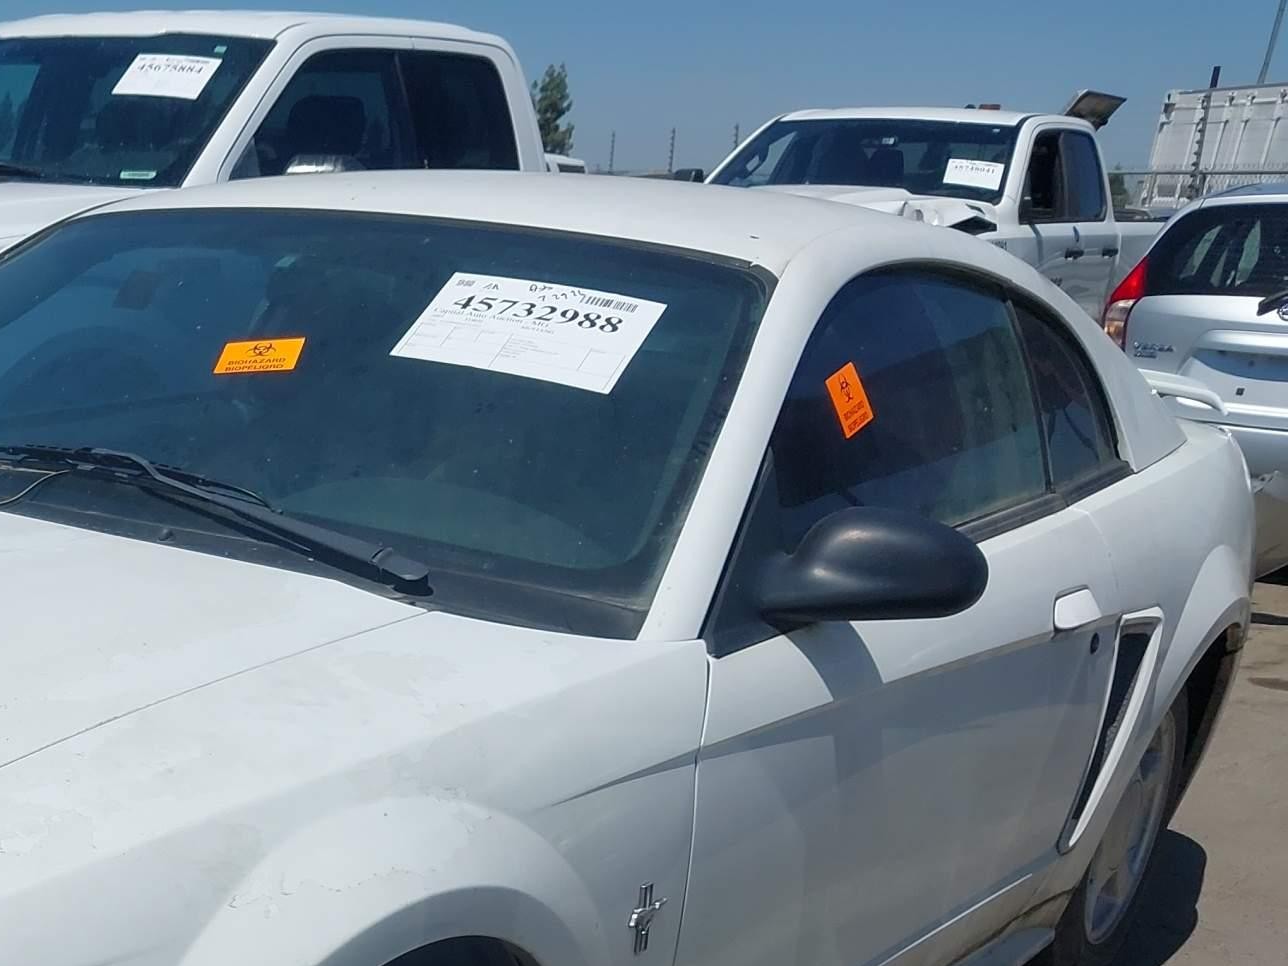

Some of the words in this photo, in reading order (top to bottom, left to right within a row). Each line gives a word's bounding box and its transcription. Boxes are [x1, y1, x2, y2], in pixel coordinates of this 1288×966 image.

[433, 307, 465, 318] Capital
[466, 311, 488, 319] Auto
[489, 314, 523, 324] Auction
[453, 294, 624, 334] 45732988
[227, 357, 286, 365] BIOHAZARD
